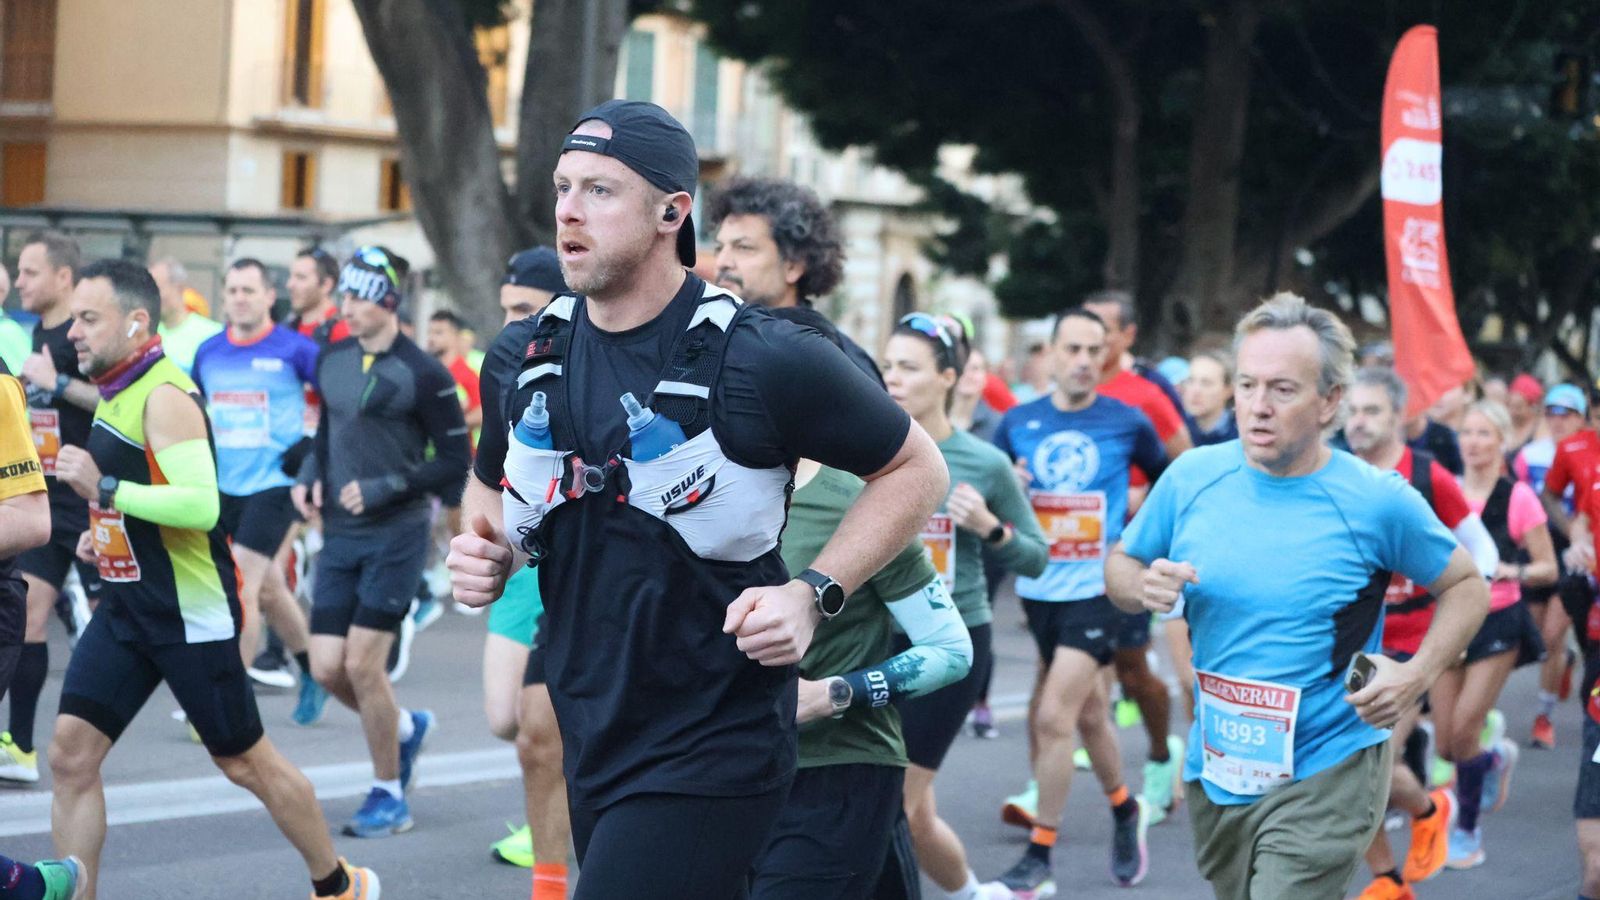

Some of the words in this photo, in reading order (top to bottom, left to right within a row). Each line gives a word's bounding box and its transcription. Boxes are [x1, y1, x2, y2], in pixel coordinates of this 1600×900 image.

[661, 464, 705, 506] USWE
[867, 670, 889, 708] OTSO
[1216, 681, 1287, 708] GENERALI
[1213, 713, 1267, 747] 14393
